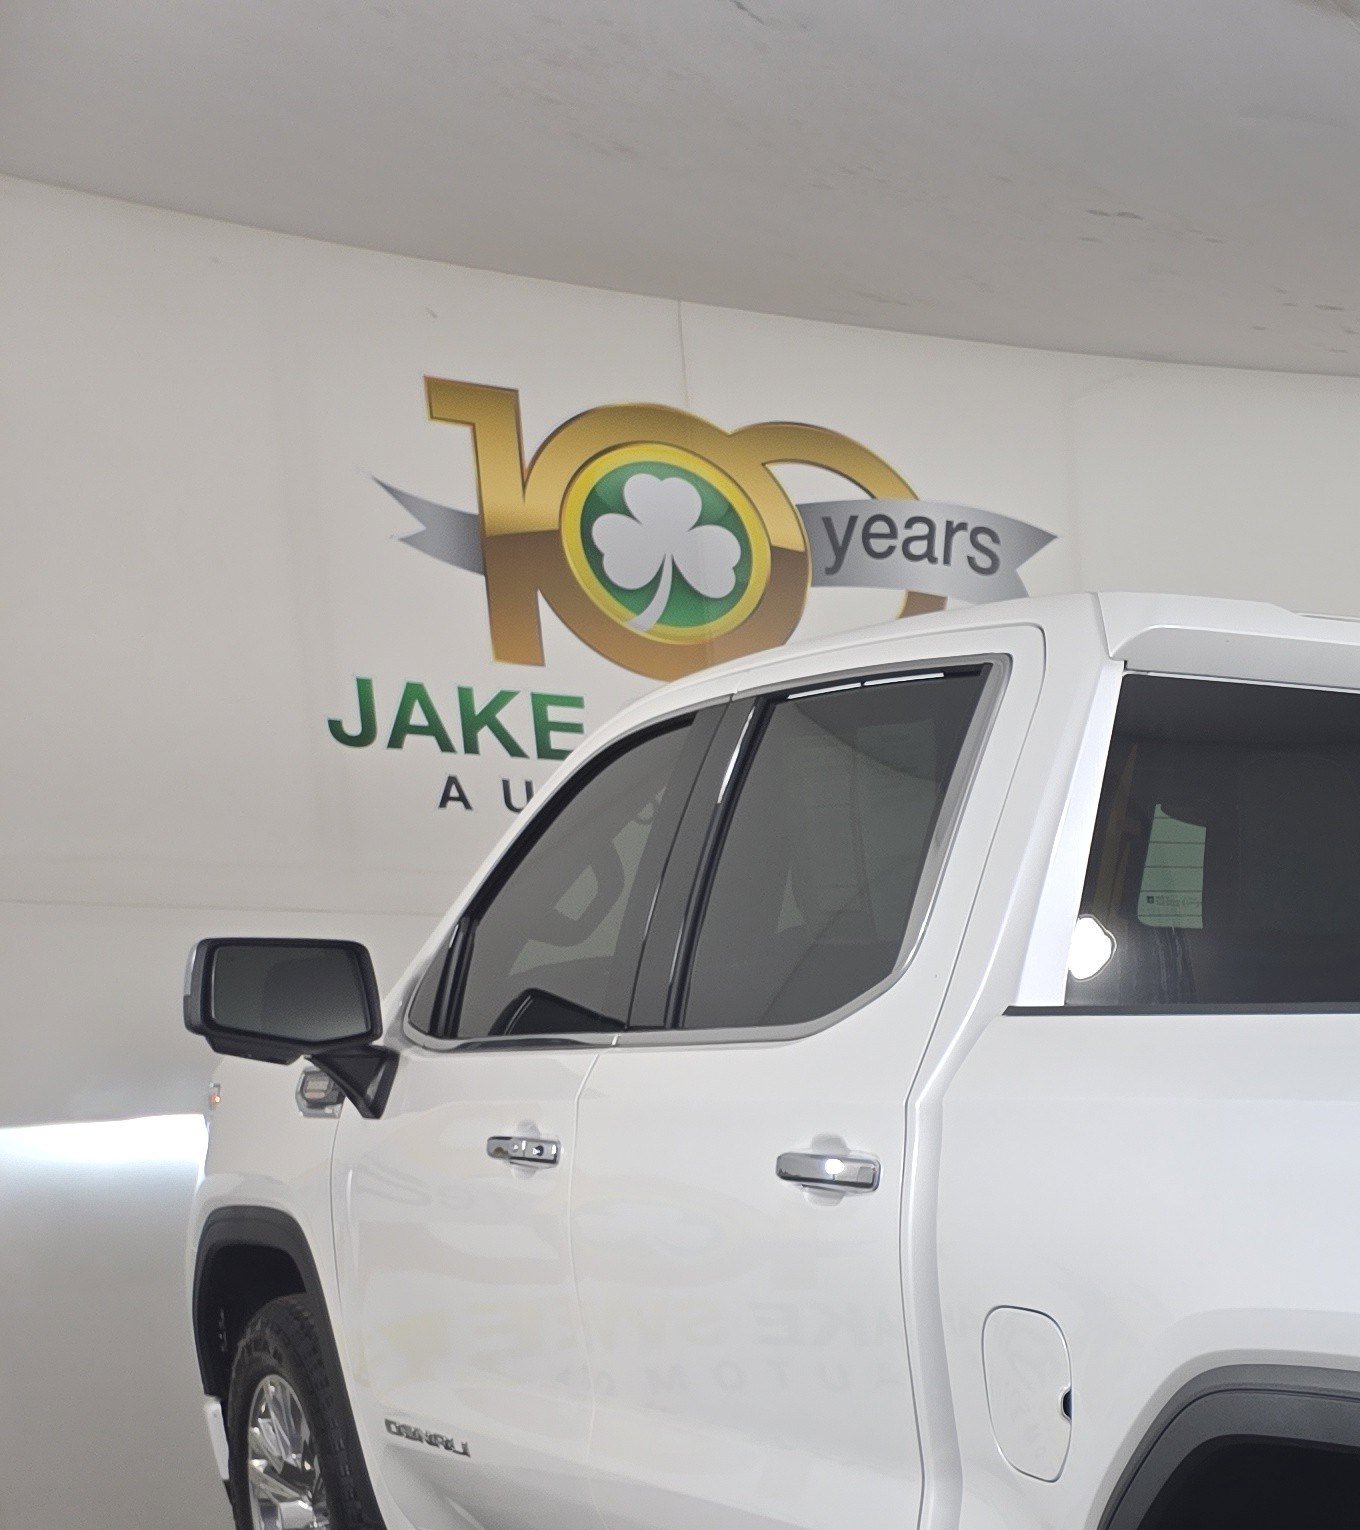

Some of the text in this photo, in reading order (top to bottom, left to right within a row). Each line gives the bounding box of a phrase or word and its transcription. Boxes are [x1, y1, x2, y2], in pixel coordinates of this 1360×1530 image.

[820, 512, 1002, 577] years
[327, 675, 585, 761] JAKE
[384, 1418, 471, 1458] DENALI
